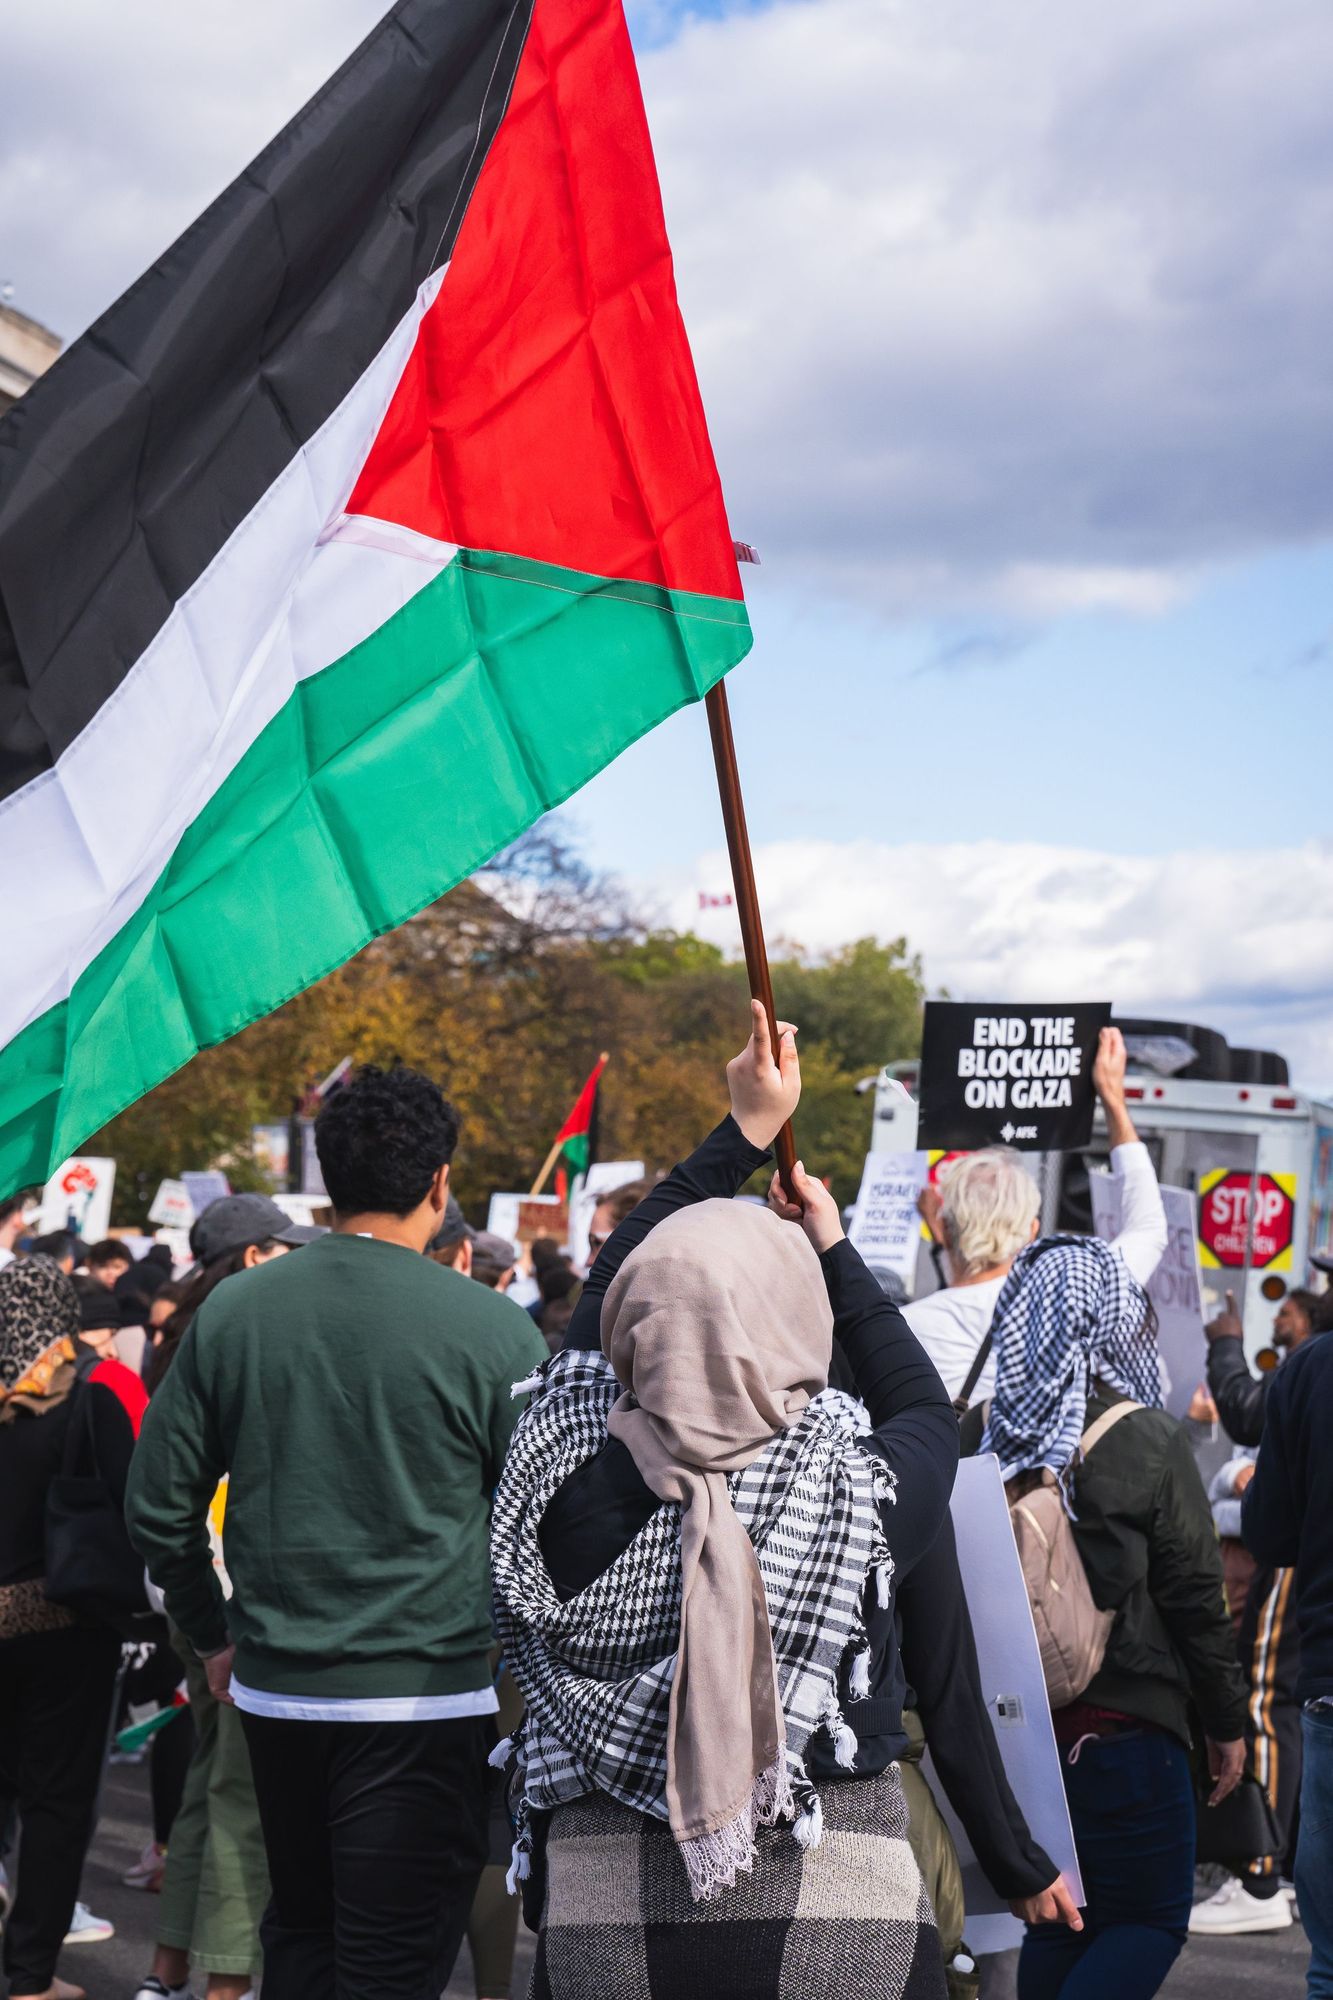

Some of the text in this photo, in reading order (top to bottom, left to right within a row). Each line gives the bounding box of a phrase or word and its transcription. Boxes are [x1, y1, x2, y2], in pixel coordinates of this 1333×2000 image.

[973, 1017, 1075, 1046] END THE
[957, 1047, 1082, 1078] BLOCKADE
[964, 1078, 1073, 1108] ON GAZA
[1211, 1186, 1284, 1226] STOP
